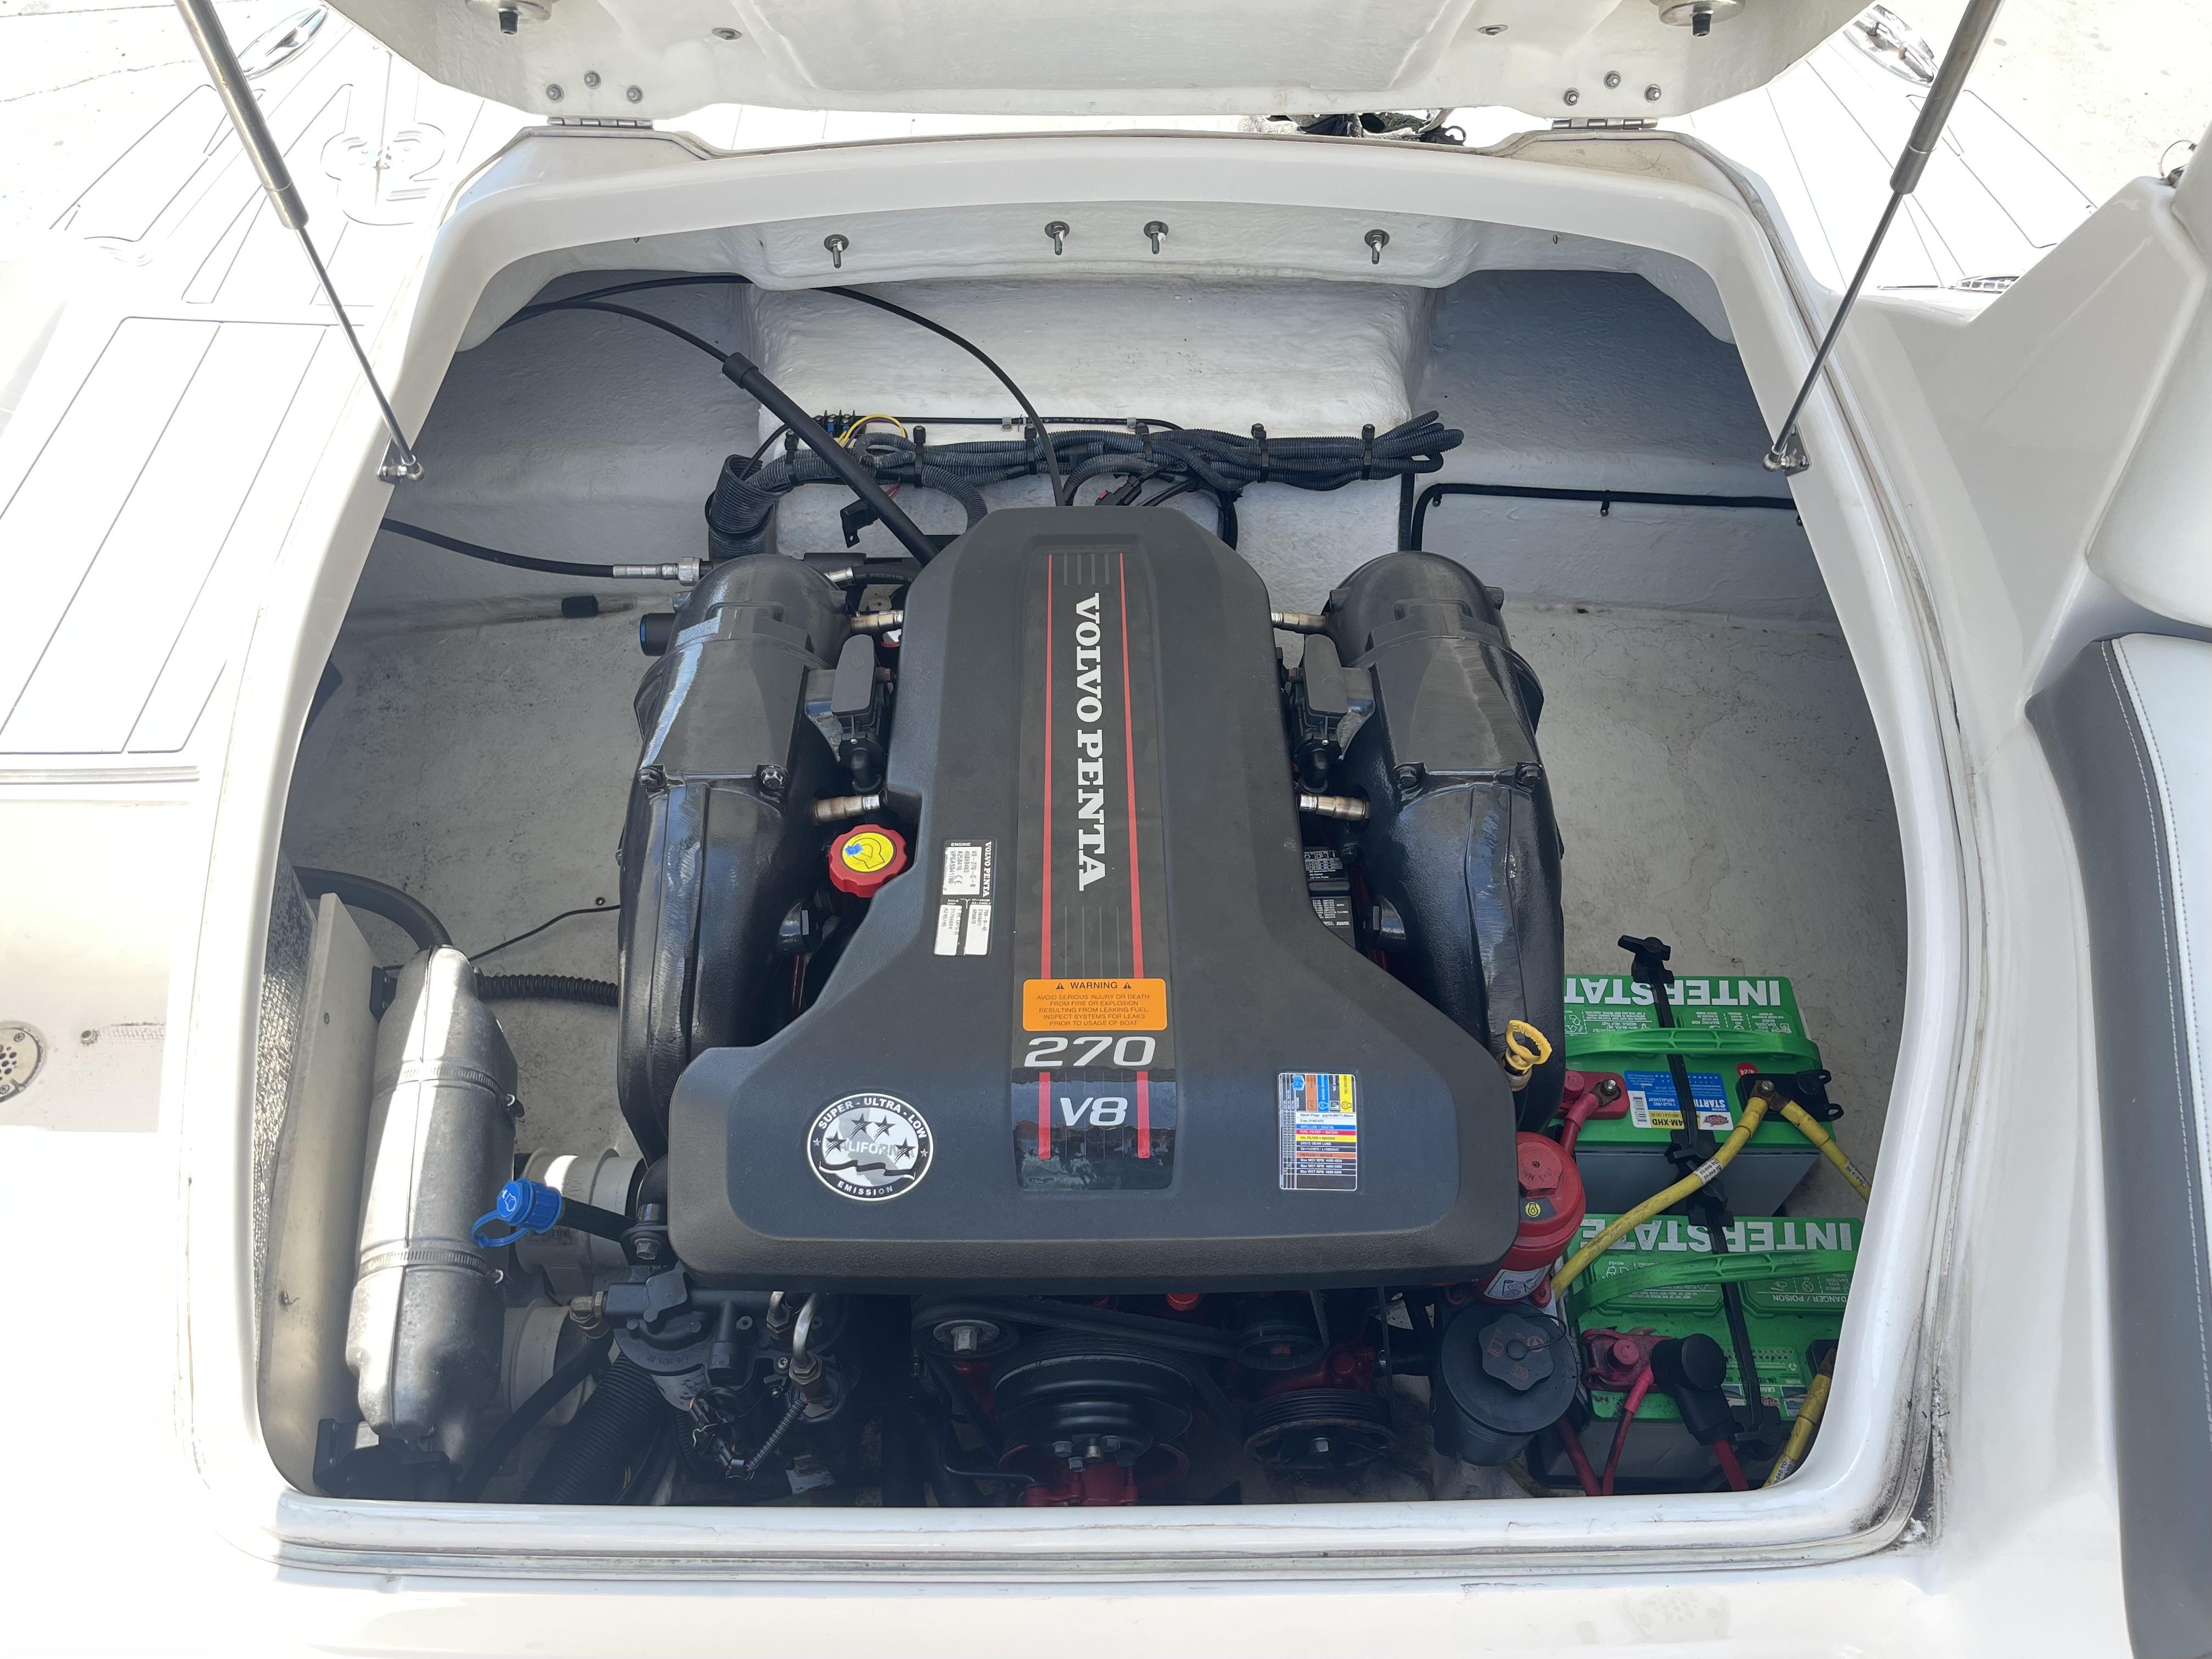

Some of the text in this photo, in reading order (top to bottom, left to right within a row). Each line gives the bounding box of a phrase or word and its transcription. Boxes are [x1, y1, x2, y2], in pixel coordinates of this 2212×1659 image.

[1076, 593, 1106, 891] VOLVO PENTA
[983, 868, 991, 897] PENTA
[1070, 981, 1118, 989] WARNING
[1024, 1036, 1156, 1067] 270
[818, 1100, 854, 1129] SUPER
[864, 1098, 901, 1114] ULTRA
[908, 1114, 927, 1139] LOW
[1060, 1097, 1128, 1127] V8
[837, 1180, 894, 1195] EMISSION
